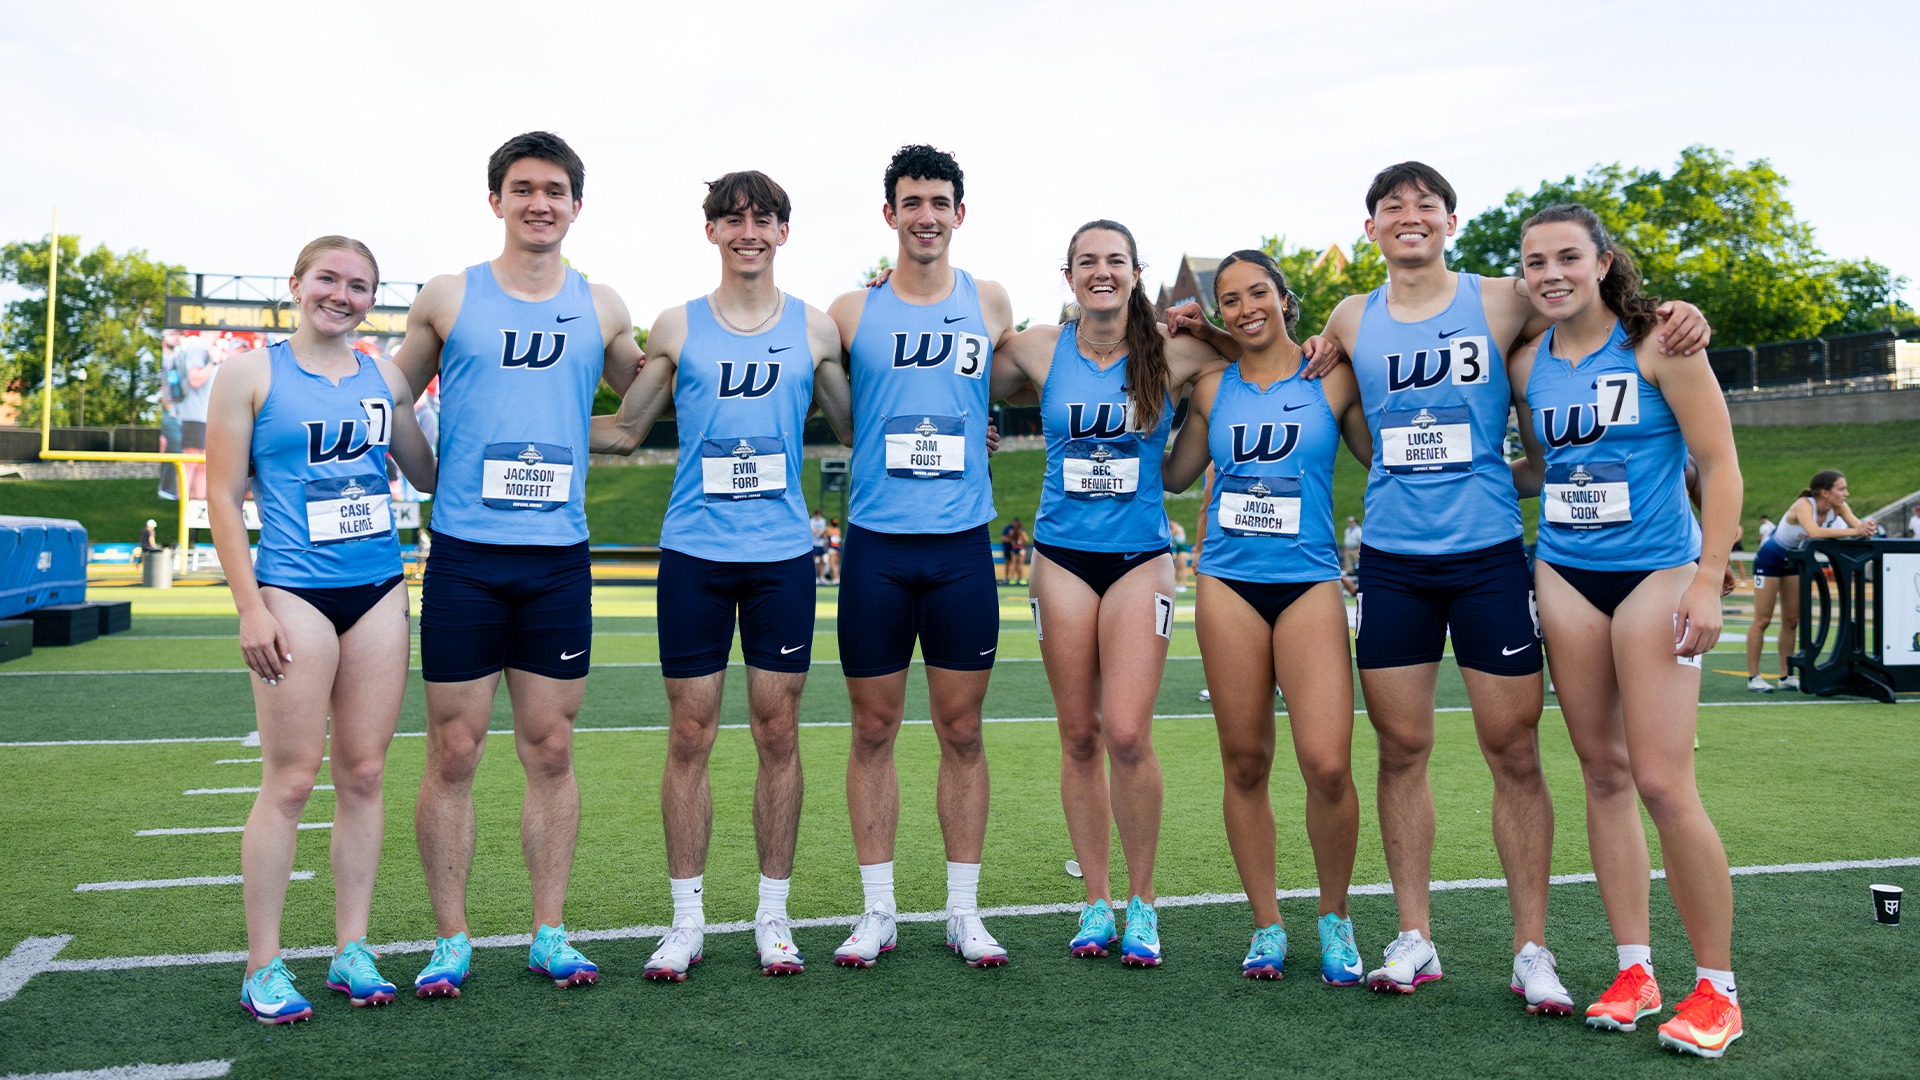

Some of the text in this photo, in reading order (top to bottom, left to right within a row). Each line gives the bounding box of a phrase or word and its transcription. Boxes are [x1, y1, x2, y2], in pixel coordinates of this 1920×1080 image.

[499, 329, 567, 370] W
[891, 332, 955, 369] W
[961, 337, 980, 375] 3
[1459, 341, 1480, 382] 3
[1382, 347, 1452, 394] W
[716, 361, 782, 399] W
[1606, 379, 1627, 422] 7
[371, 403, 386, 442] 7
[915, 440, 937, 452] SAM
[1228, 423, 1302, 464] W
[1407, 432, 1443, 446] LUCAS
[910, 453, 942, 466] FOUST
[1405, 447, 1448, 461] BRENEK
[503, 467, 555, 483] JACKSON
[733, 462, 757, 475] EVIN
[1092, 465, 1111, 476] BEC
[732, 476, 759, 489] FORD
[1081, 478, 1123, 490] BENNETT
[505, 483, 551, 497] MOFFITT
[1560, 490, 1607, 504] KENNEDY
[340, 502, 371, 518] CASIE
[1242, 500, 1275, 514] JAYDA
[1571, 506, 1599, 519] COOK
